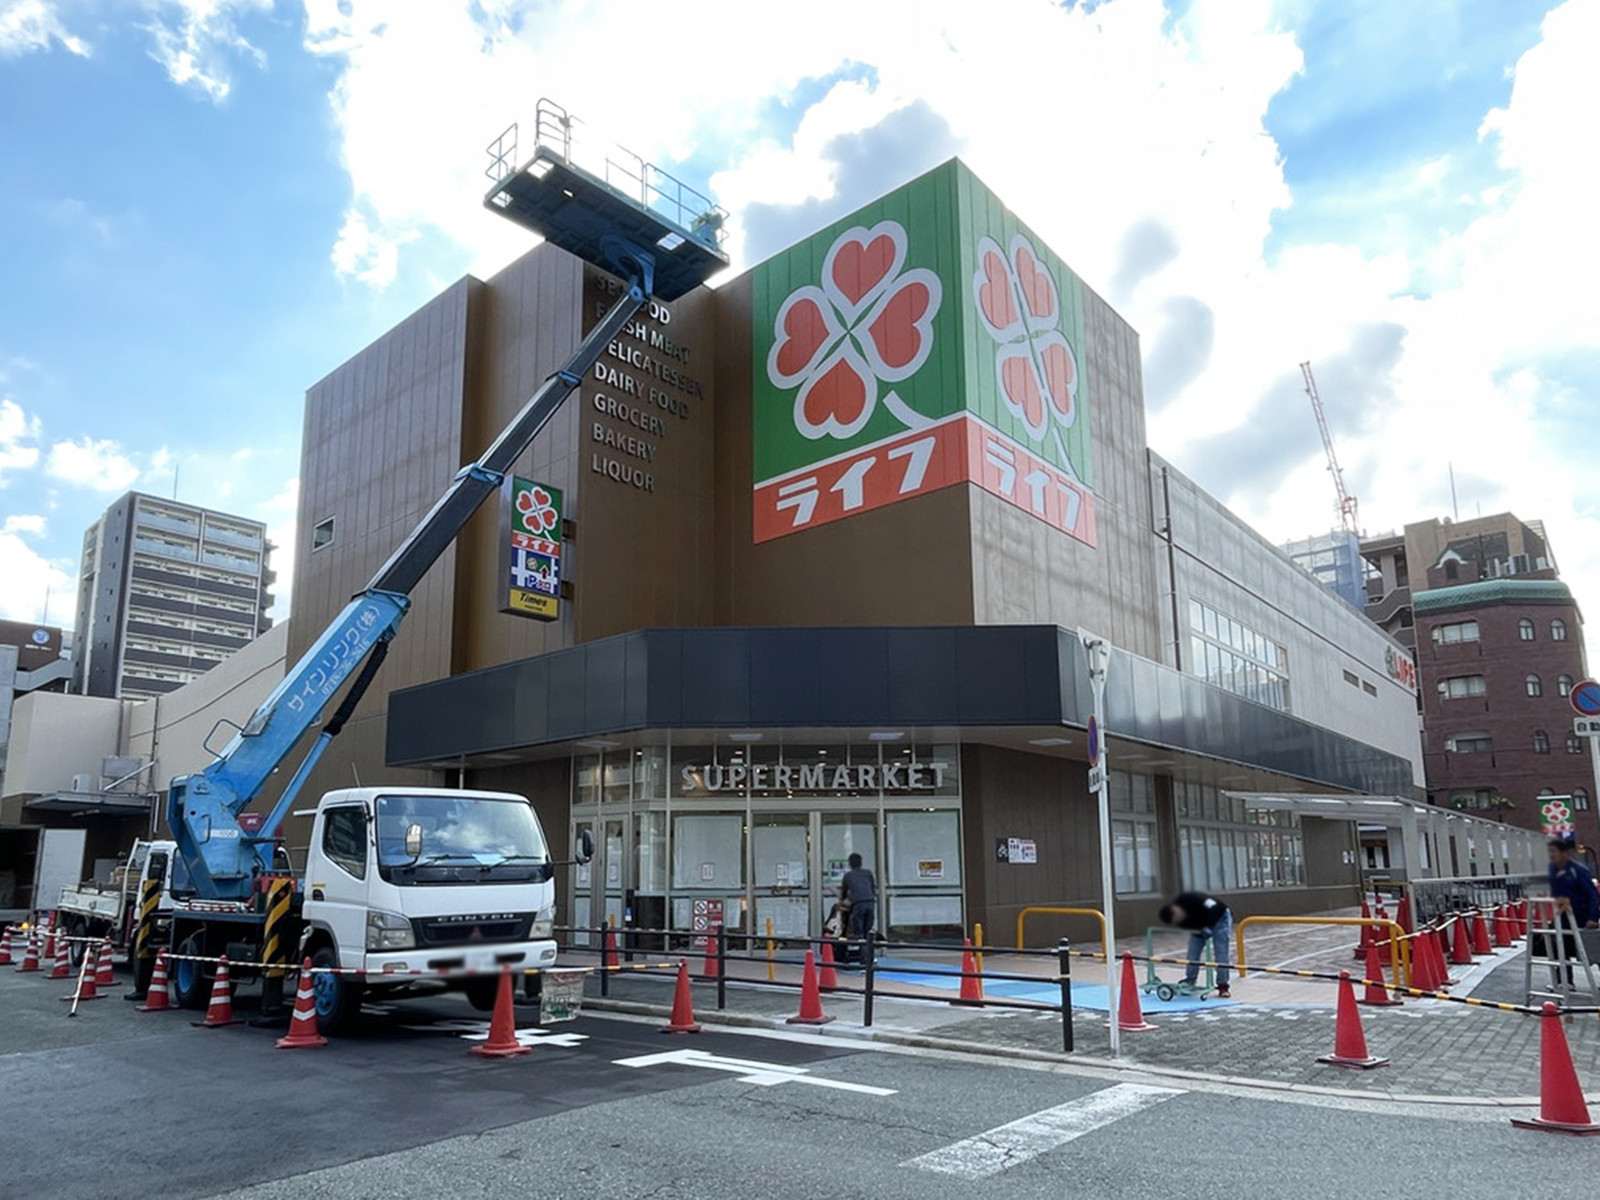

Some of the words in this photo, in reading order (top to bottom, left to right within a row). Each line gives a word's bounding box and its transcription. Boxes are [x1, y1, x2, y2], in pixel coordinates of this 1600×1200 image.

[650, 329, 692, 363] MEAT
[607, 340, 705, 398] ELICATESSEN
[594, 361, 645, 398] DAIRY
[648, 386, 690, 419] FOOD
[593, 393, 667, 436] GROCERY
[592, 423, 656, 461] BAKERY
[592, 453, 655, 491] LIQUOR
[776, 436, 936, 527] ライフ
[985, 436, 1081, 532] ライフ
[517, 534, 555, 554] ライフ
[519, 592, 548, 607] Times
[1394, 654, 1415, 689] LIFE
[681, 763, 948, 791] SUPERMARKET
